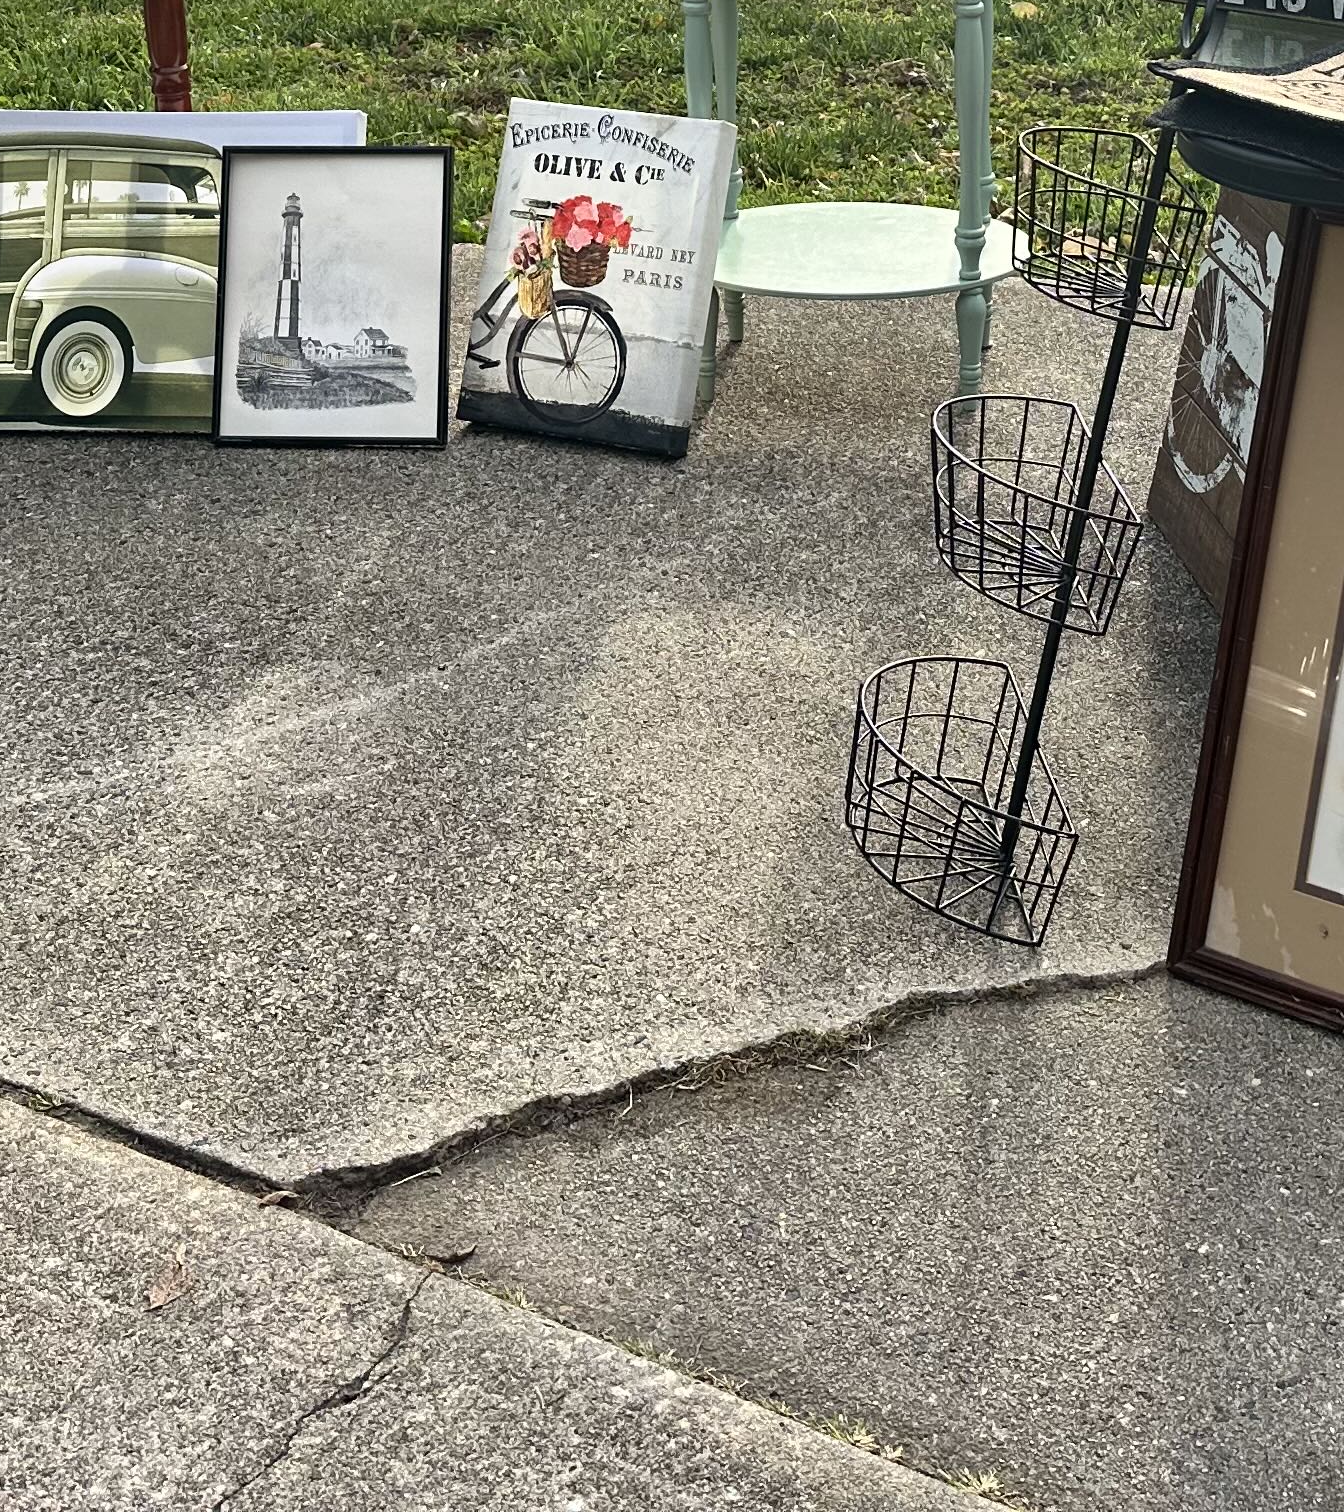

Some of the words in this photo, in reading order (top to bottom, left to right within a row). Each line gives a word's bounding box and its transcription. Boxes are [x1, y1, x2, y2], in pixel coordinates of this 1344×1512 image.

[534, 152, 603, 180] OLIVE
[610, 161, 627, 183] &
[622, 268, 684, 291] PARIS
